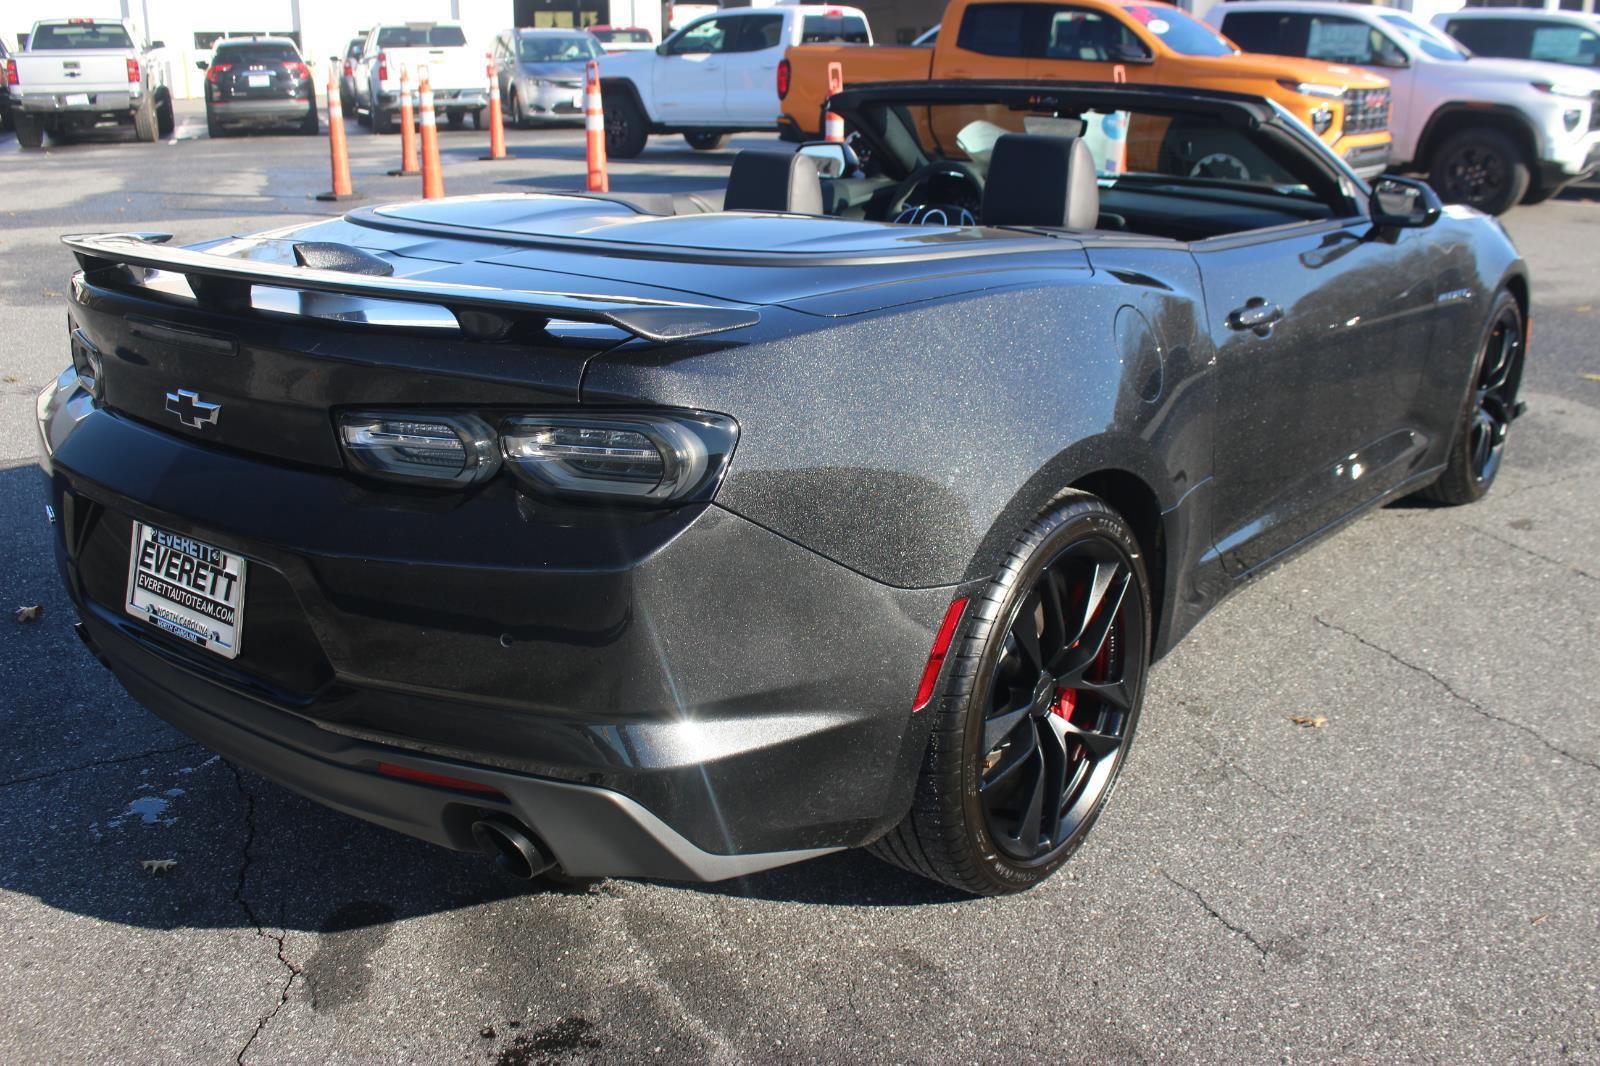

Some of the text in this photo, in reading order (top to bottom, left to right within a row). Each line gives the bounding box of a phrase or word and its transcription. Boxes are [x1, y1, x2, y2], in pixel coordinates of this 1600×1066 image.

[157, 531, 214, 561] EVERETT
[140, 540, 237, 602] EVERETT
[138, 574, 235, 624] EVERETTAUTOTEAM.COM
[157, 607, 209, 636] NORTH CAROLINA
[157, 620, 198, 643] NORTH CAROLINA
